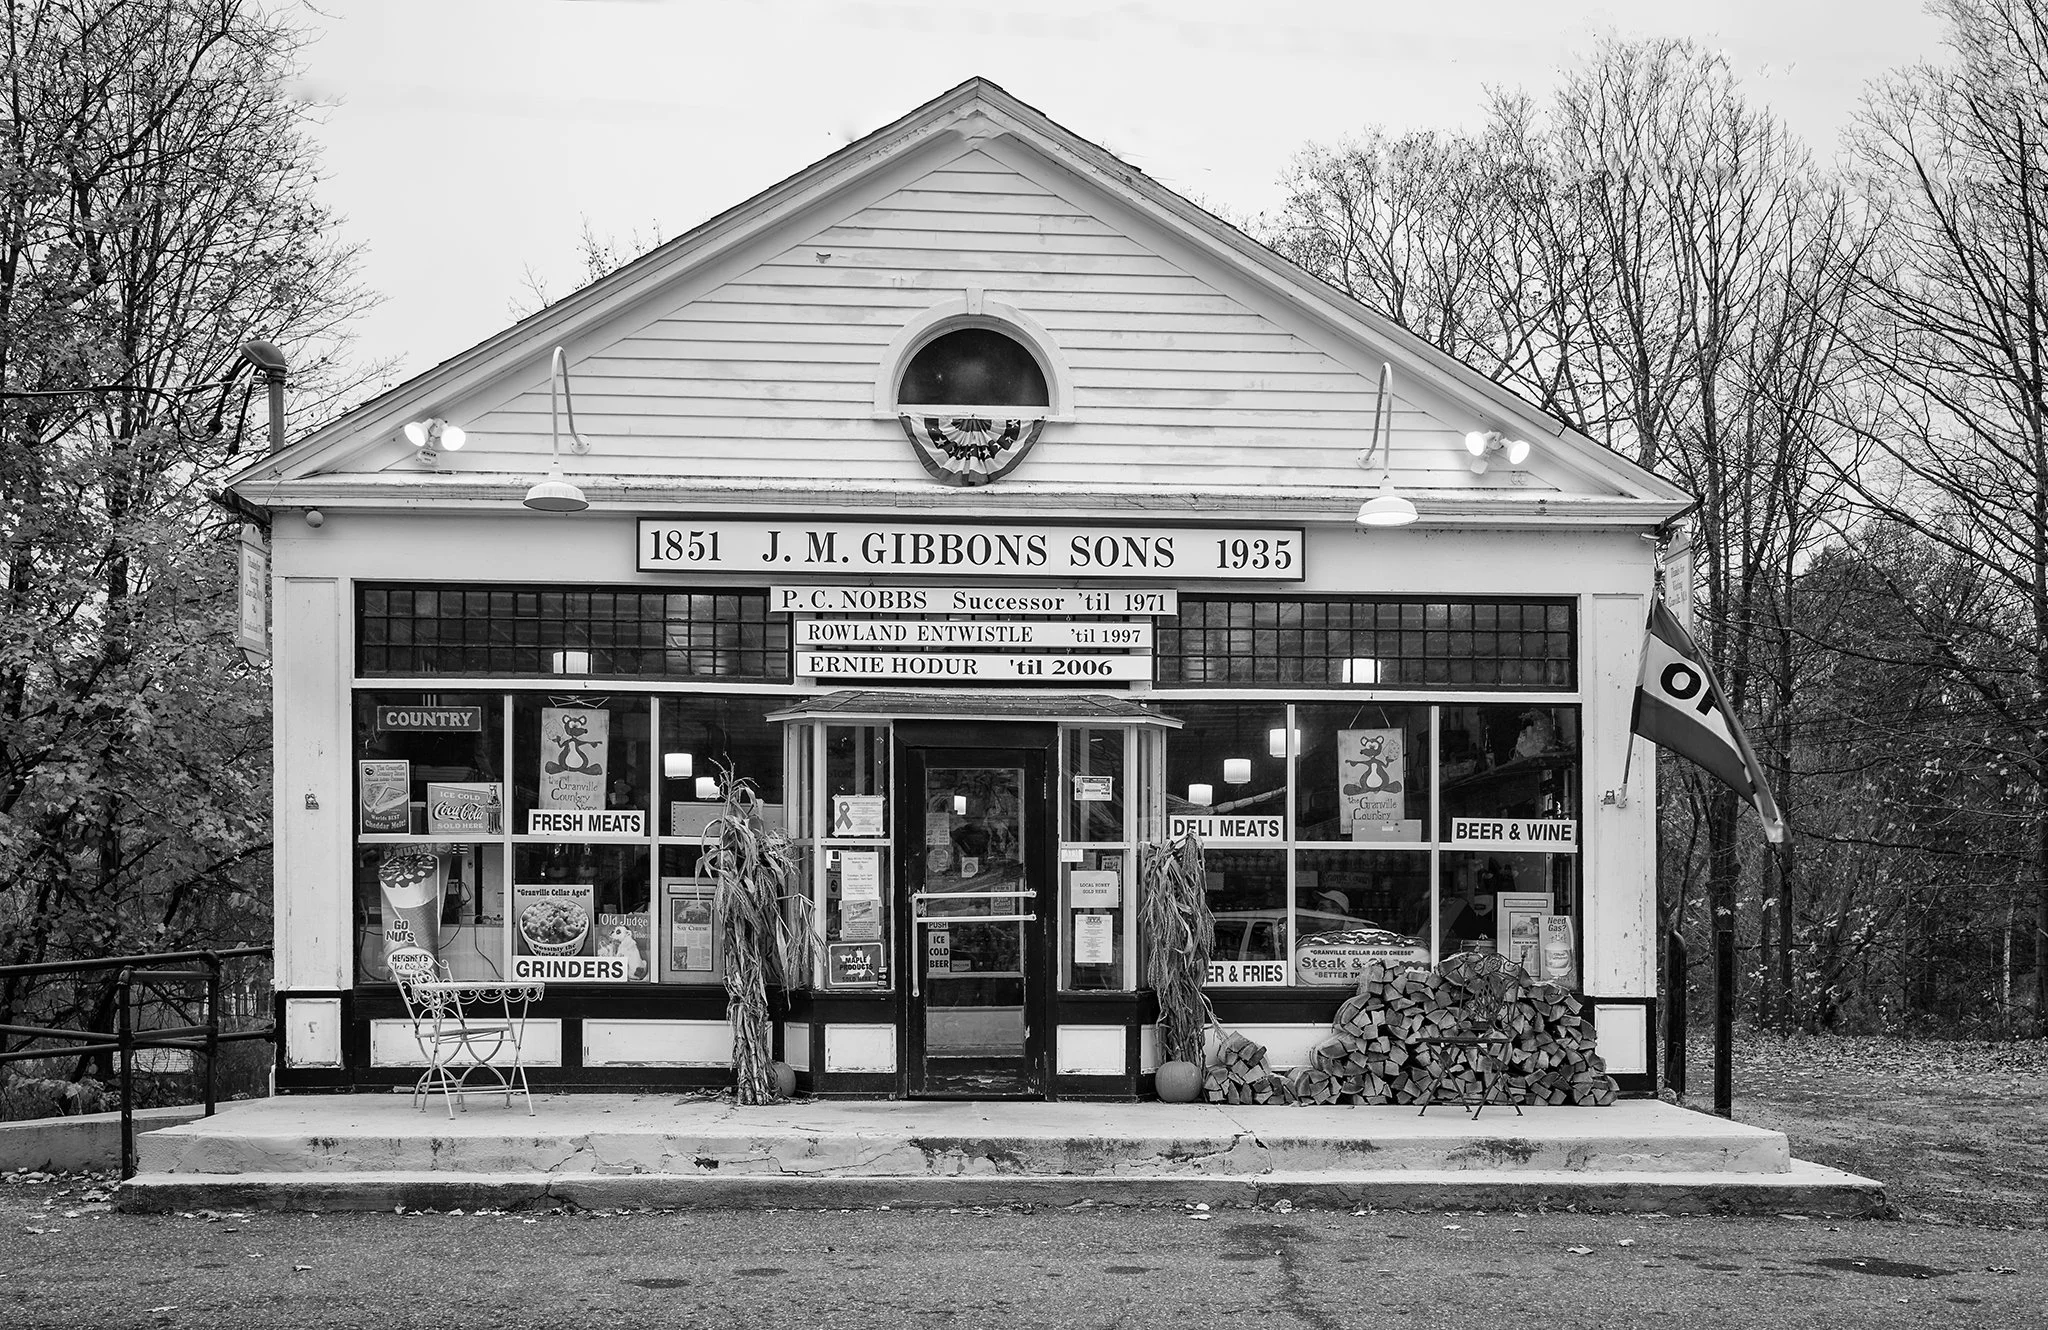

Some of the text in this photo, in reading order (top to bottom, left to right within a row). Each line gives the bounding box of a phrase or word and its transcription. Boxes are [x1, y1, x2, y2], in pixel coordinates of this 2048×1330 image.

[650, 530, 1292, 570] 1851 J. M. GIBBONS SONS 1935
[781, 590, 804, 608] P.
[810, 590, 833, 609] C.
[840, 590, 928, 610] NOBBS
[952, 590, 1065, 611] Successor
[1124, 594, 1166, 612] 1971
[808, 624, 907, 641] ROWLAND
[917, 625, 1034, 643] ENTWISTLE
[1102, 629, 1141, 644] 1997
[808, 656, 884, 674] ERNIE
[891, 657, 979, 675] HODUR
[1051, 659, 1113, 676] 2006
[386, 712, 472, 726] COUNTRY
[558, 776, 598, 792] Granville
[550, 788, 590, 803] Country
[1360, 796, 1398, 810] Granville
[1353, 808, 1391, 820] Country
[532, 814, 641, 832] FRESH MEATS
[1174, 820, 1280, 837] DELI MEATS
[1456, 822, 1572, 841] BEER & WINE
[393, 920, 409, 930] GO
[601, 914, 649, 928] Old Judge
[386, 930, 415, 942] NUTS
[930, 948, 949, 956] COLD
[516, 960, 624, 978] GRINDERS
[1302, 957, 1346, 969] Steak
[1352, 958, 1362, 969] &
[1229, 965, 1239, 982] &
[1243, 965, 1283, 982] FRIES
